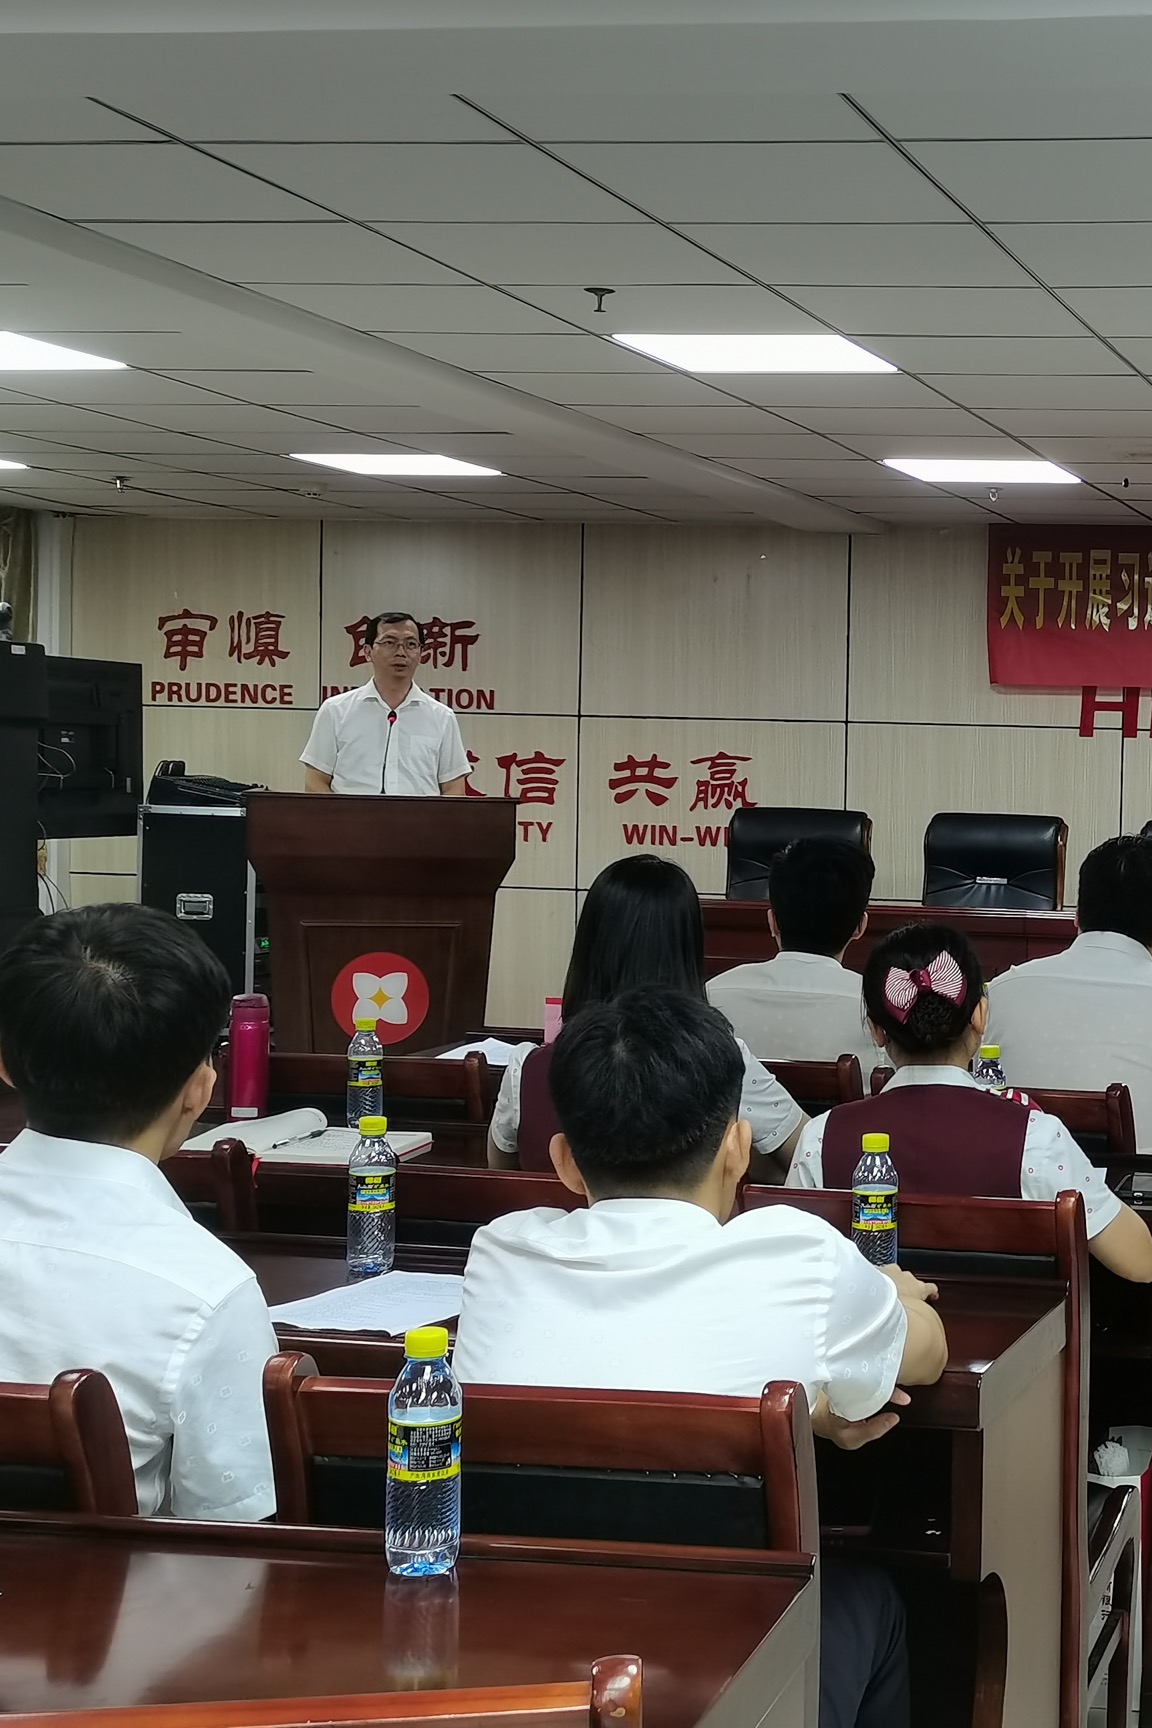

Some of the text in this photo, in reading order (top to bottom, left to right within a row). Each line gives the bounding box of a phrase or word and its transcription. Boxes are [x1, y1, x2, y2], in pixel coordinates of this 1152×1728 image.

[157, 608, 291, 671] 审慎
[151, 681, 294, 704] PRUDENCE
[609, 752, 758, 812] 共赢
[622, 824, 730, 847] WIN-WI
